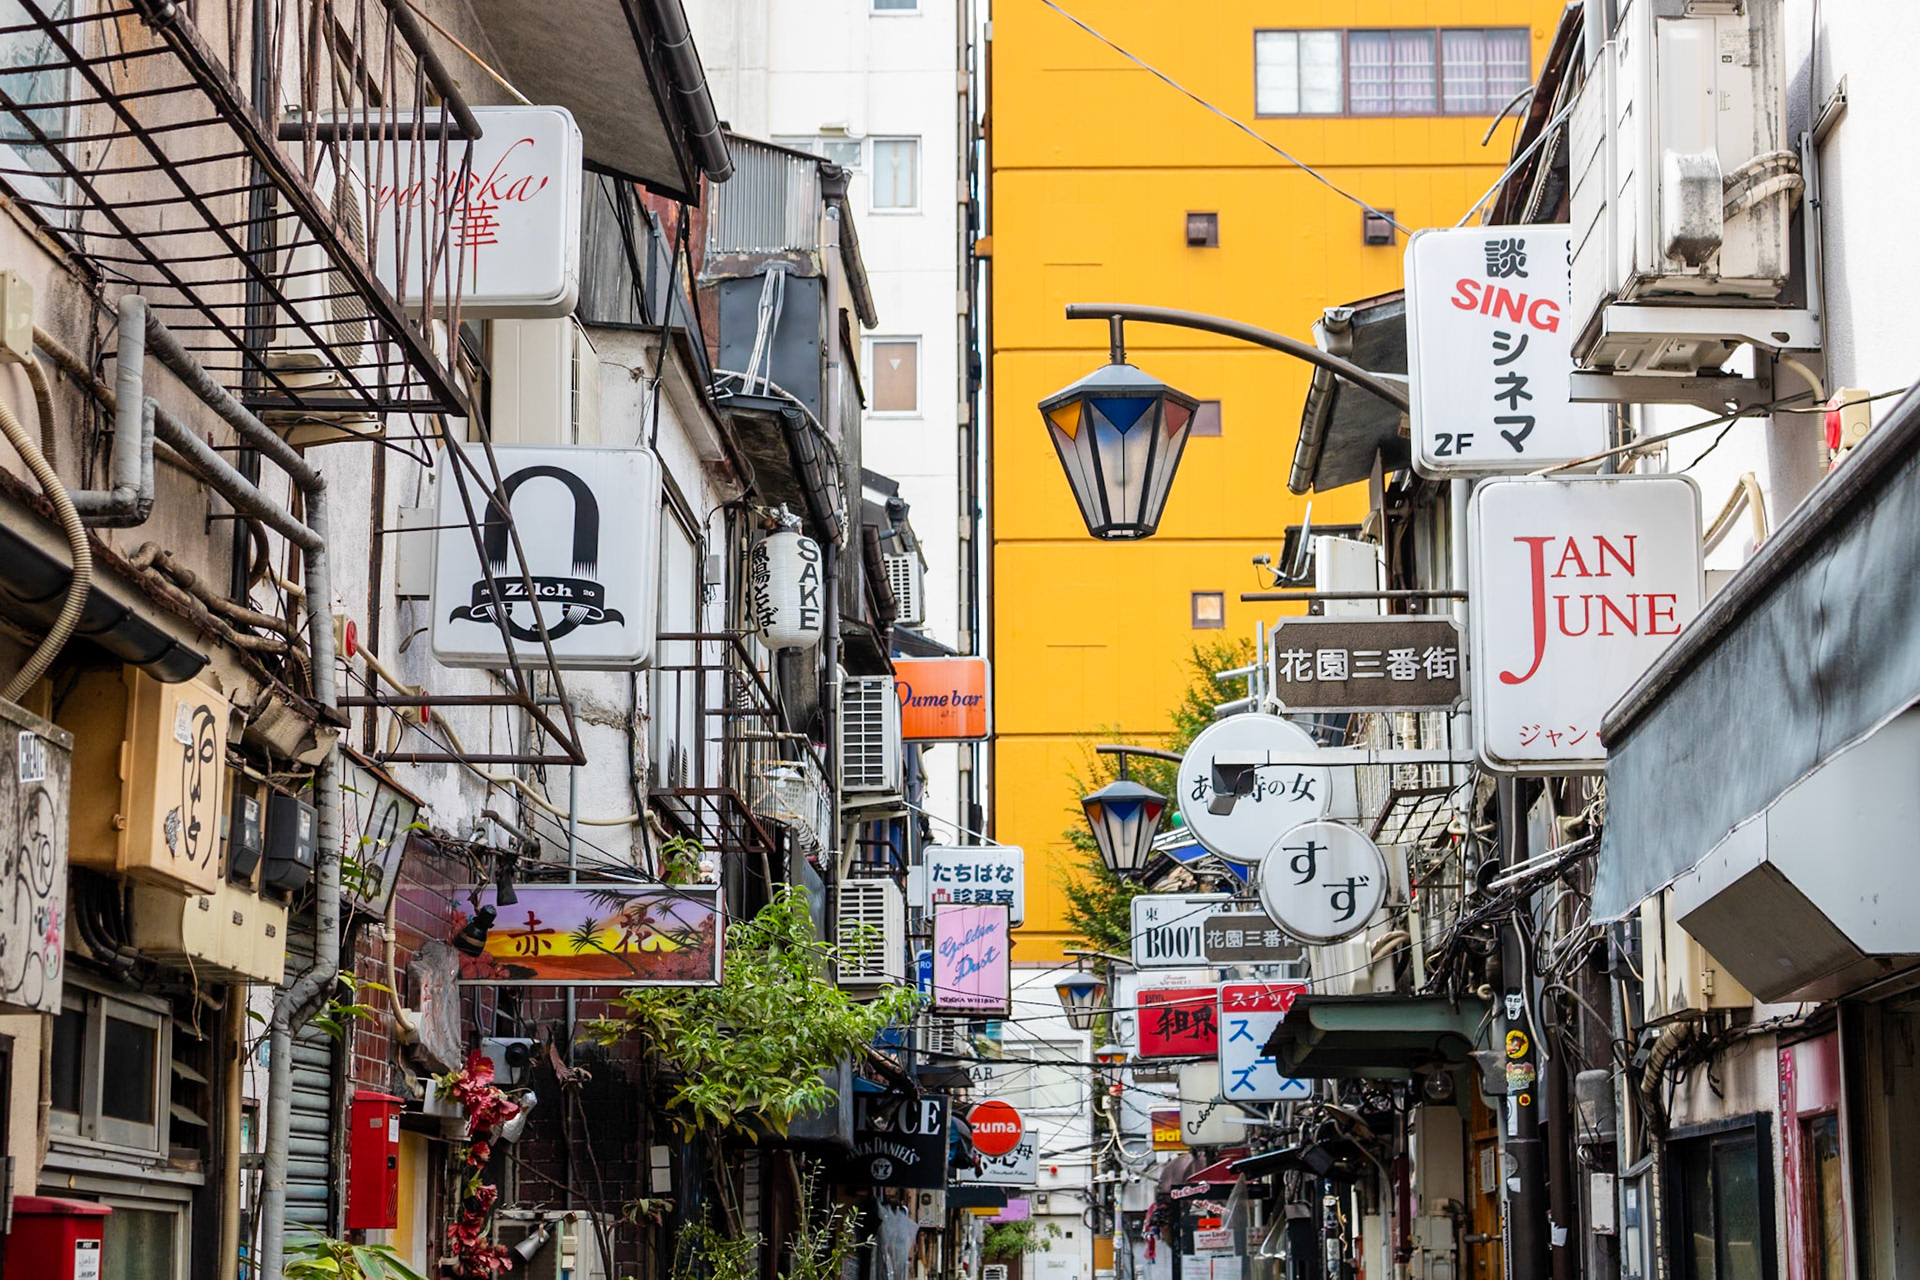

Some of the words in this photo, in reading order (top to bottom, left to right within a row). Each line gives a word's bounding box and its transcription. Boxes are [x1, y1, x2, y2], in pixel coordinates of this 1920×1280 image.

[1484, 238, 1529, 278] 談
[1451, 278, 1560, 333] SING
[1493, 330, 1535, 453] シネマ
[1434, 433, 1474, 456] 2F
[797, 539, 819, 630] SAKE
[1279, 646, 1457, 683] 花園三番街
[951, 691, 983, 707] bar
[932, 863, 1014, 883] たちばな
[939, 923, 999, 967] Golden
[952, 946, 1000, 986] Dust
[967, 1067, 993, 1080] AR
